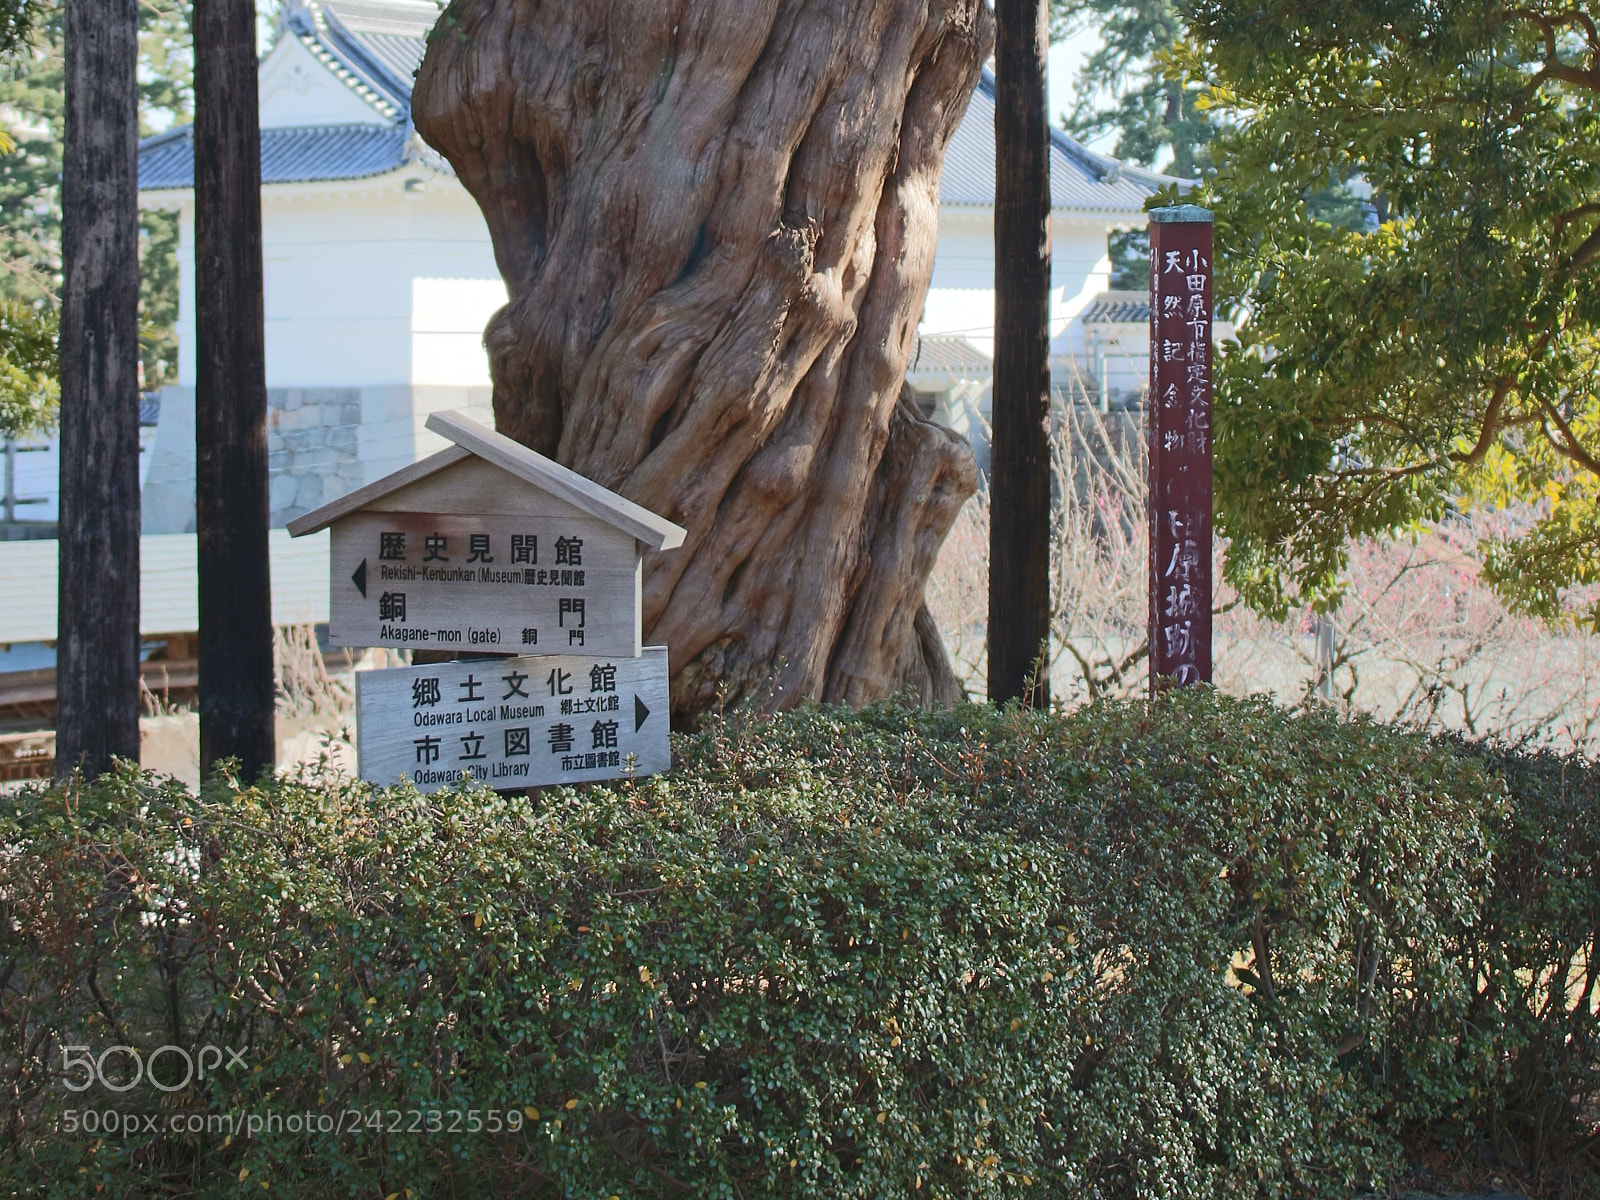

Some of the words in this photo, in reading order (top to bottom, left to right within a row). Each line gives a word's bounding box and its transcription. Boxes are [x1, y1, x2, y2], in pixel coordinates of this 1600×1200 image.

[1163, 250, 1185, 452] 天然記念物
[1185, 248, 1209, 452] 小田原市指定文化財
[379, 532, 583, 566] 歴史見聞館
[381, 565, 476, 583] Rekishi-Kenbunkan
[478, 568, 524, 585] (Museum)
[380, 625, 461, 642] Akagane-mon
[467, 627, 501, 644] (gate)
[412, 663, 617, 708] 郷土文化館
[414, 709, 462, 727] Odawara
[466, 706, 496, 722] Local
[500, 703, 545, 720] Museum
[413, 720, 619, 765] 市立図書館
[414, 768, 463, 785] Odawara
[492, 762, 530, 778] Library
